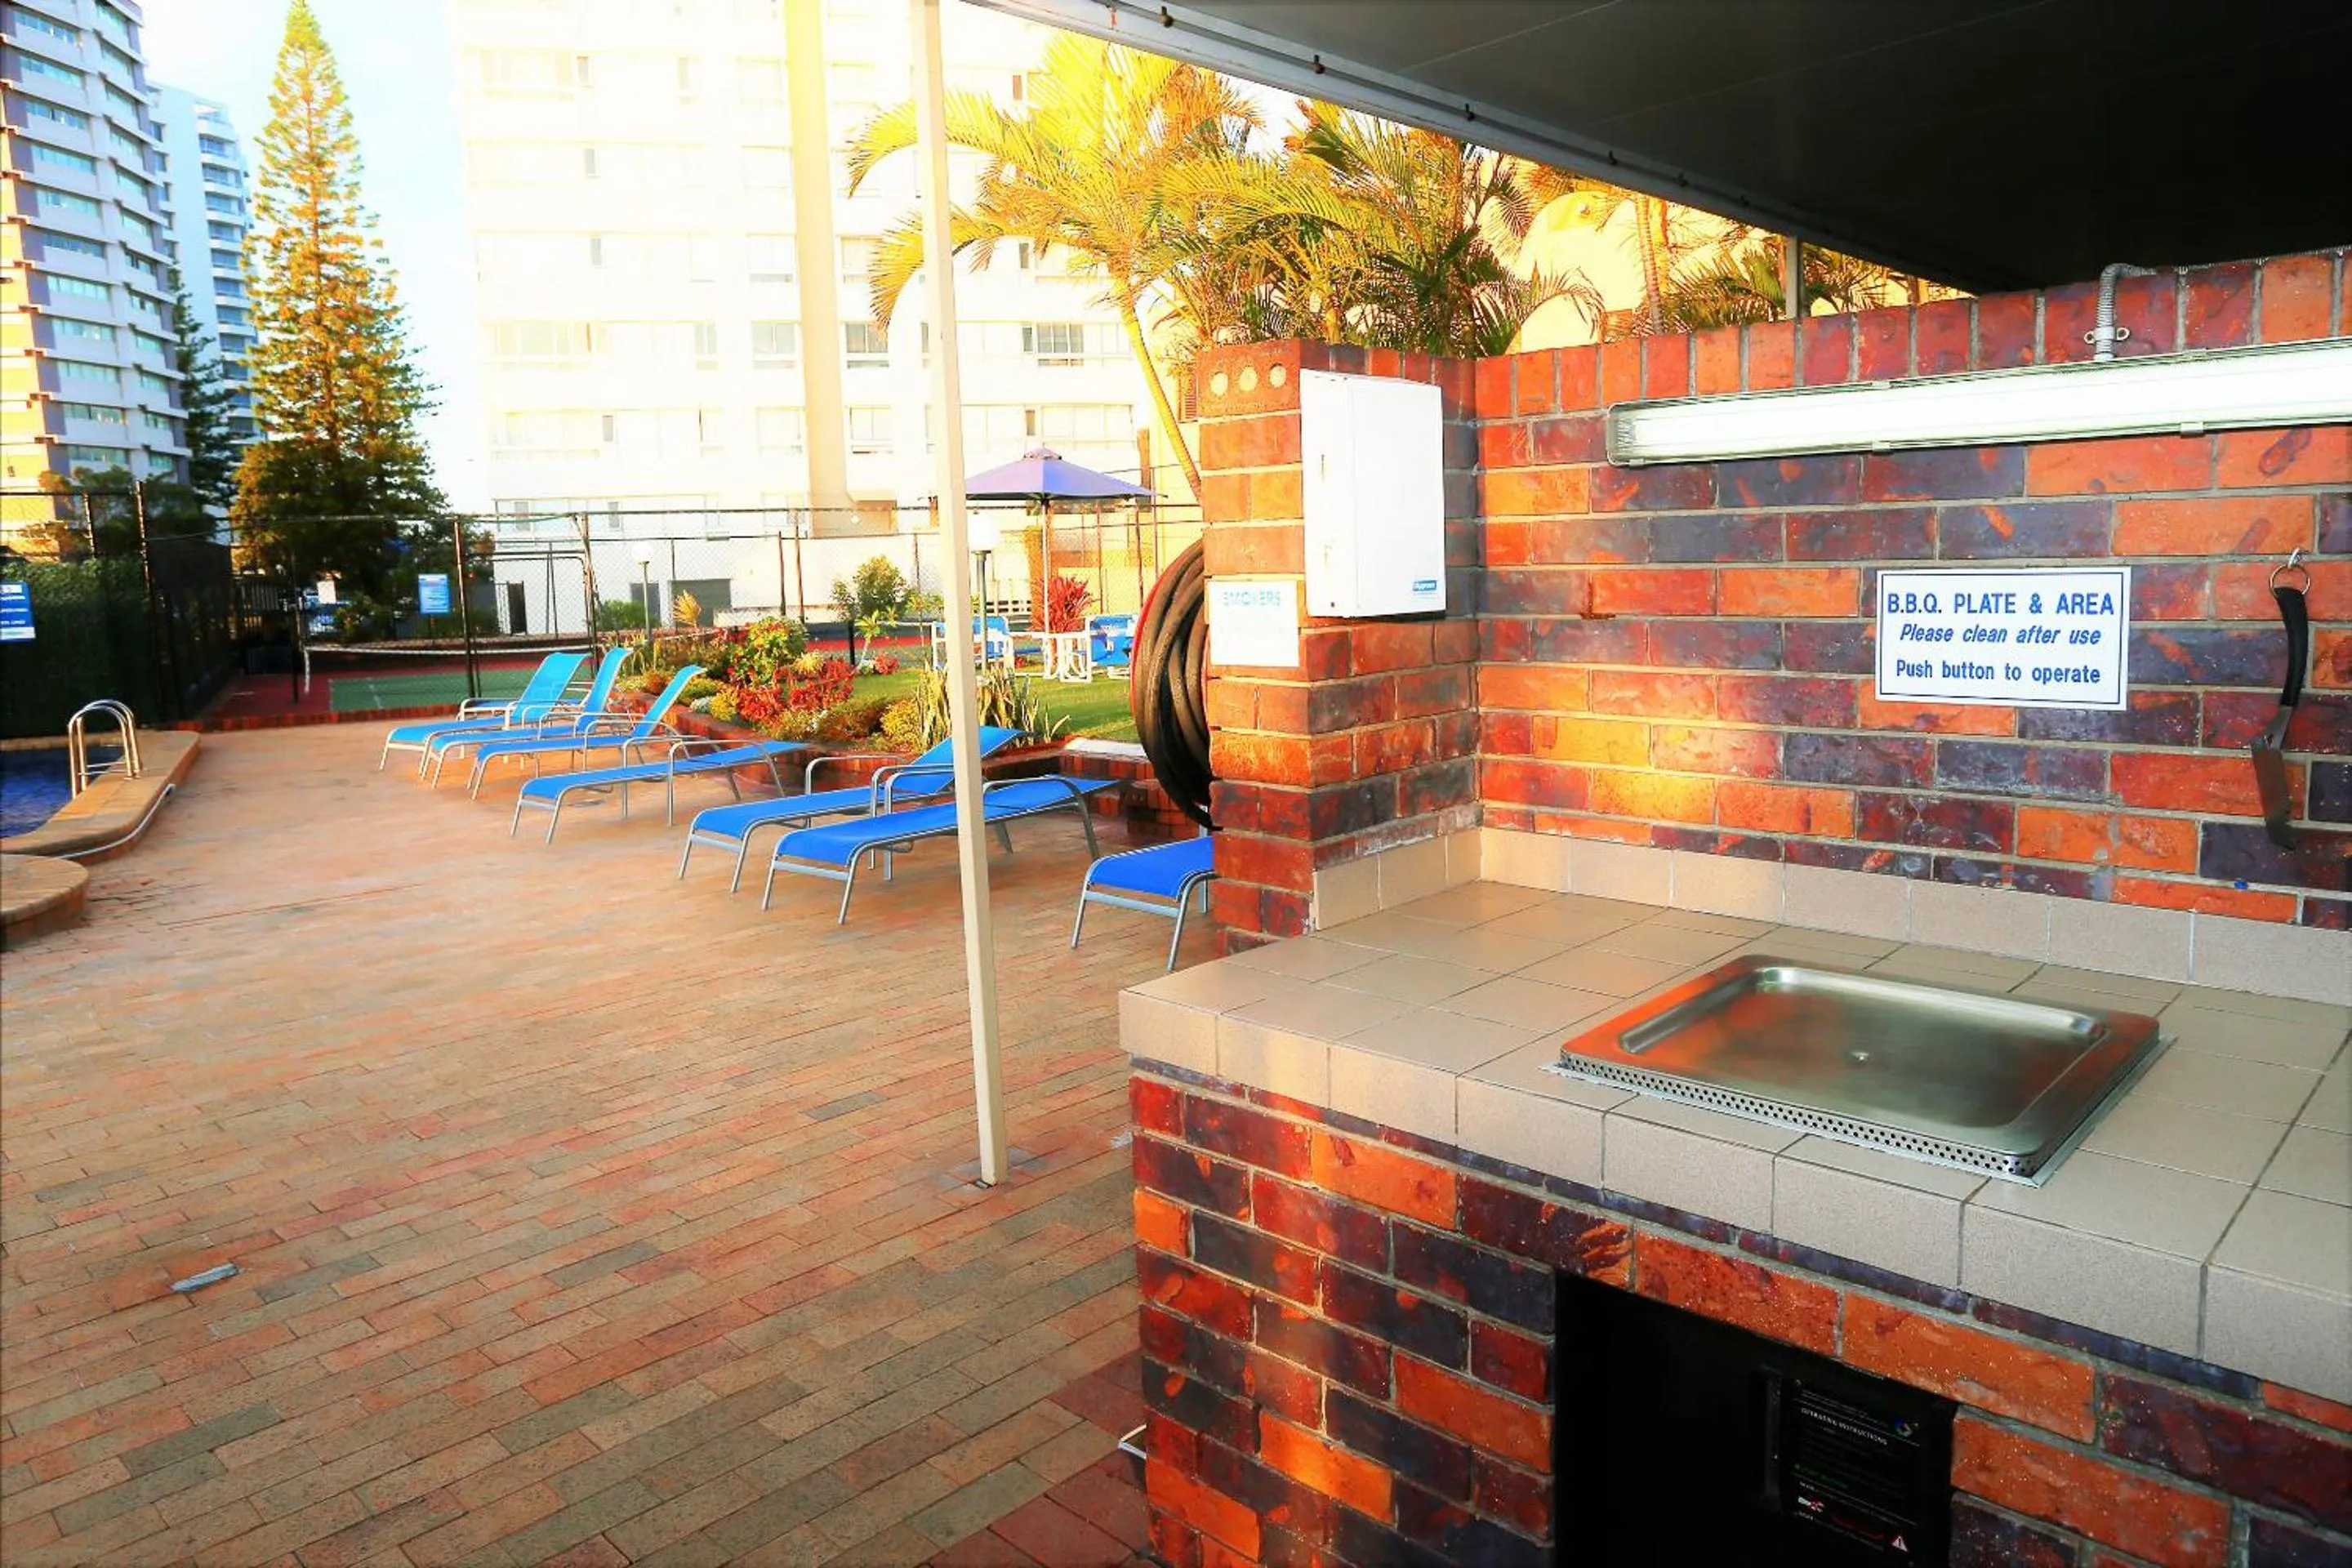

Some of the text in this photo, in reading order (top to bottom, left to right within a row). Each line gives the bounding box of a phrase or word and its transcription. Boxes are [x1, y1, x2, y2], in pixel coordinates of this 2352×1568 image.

[1887, 592, 2114, 616] B.B.Q. PLATE & AREA
[1900, 623, 2102, 645] Please clean after use
[1896, 659, 2100, 685] Push button to operate
